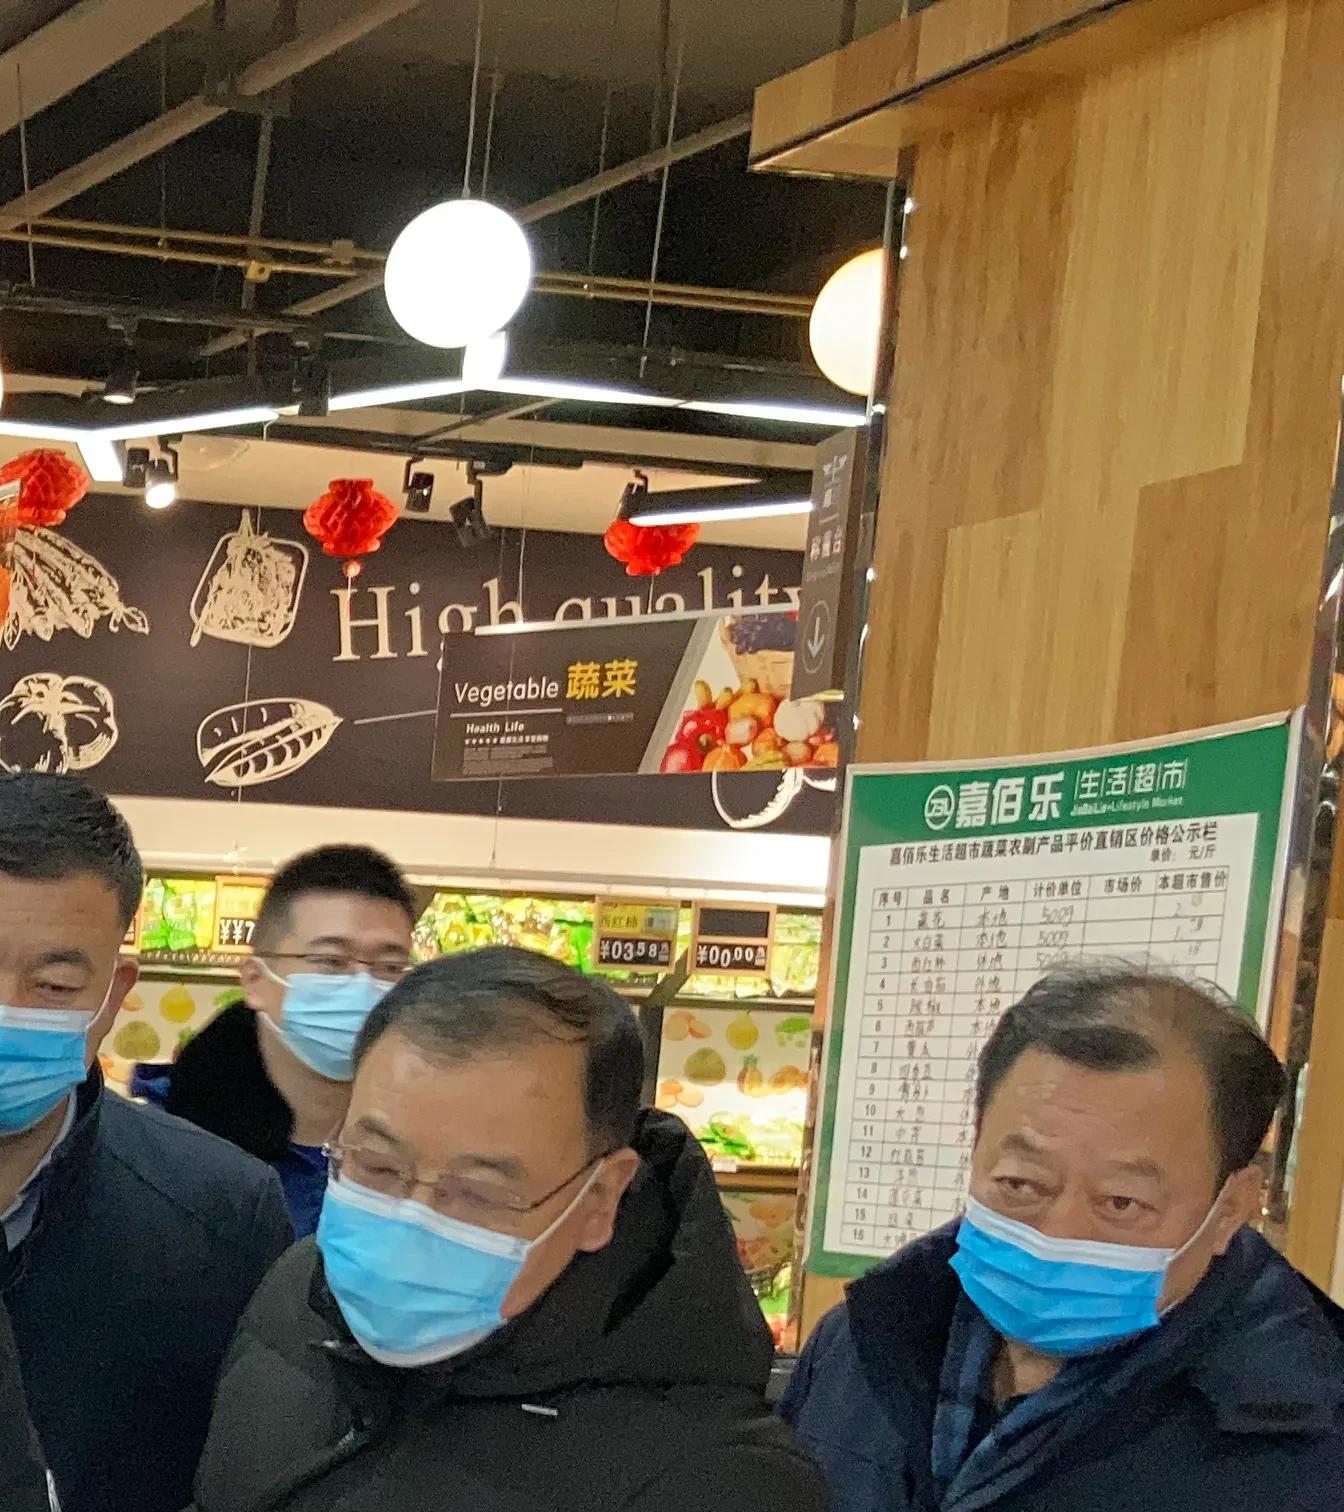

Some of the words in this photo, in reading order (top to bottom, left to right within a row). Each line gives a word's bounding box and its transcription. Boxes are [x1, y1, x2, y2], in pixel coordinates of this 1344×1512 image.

[565, 658, 639, 700] 蔬菜
[454, 675, 559, 708] Vegetable
[465, 722, 500, 735] Health
[505, 720, 525, 733] Life
[954, 770, 1066, 830] 嘉佰乐
[1076, 758, 1188, 801] 生活超市
[980, 881, 1010, 902] 产地
[1033, 878, 1083, 900] 计价单位
[865, 1104, 876, 1116] 10
[863, 1125, 874, 1137] 11
[861, 1145, 872, 1158] 12
[859, 1167, 870, 1179] 13
